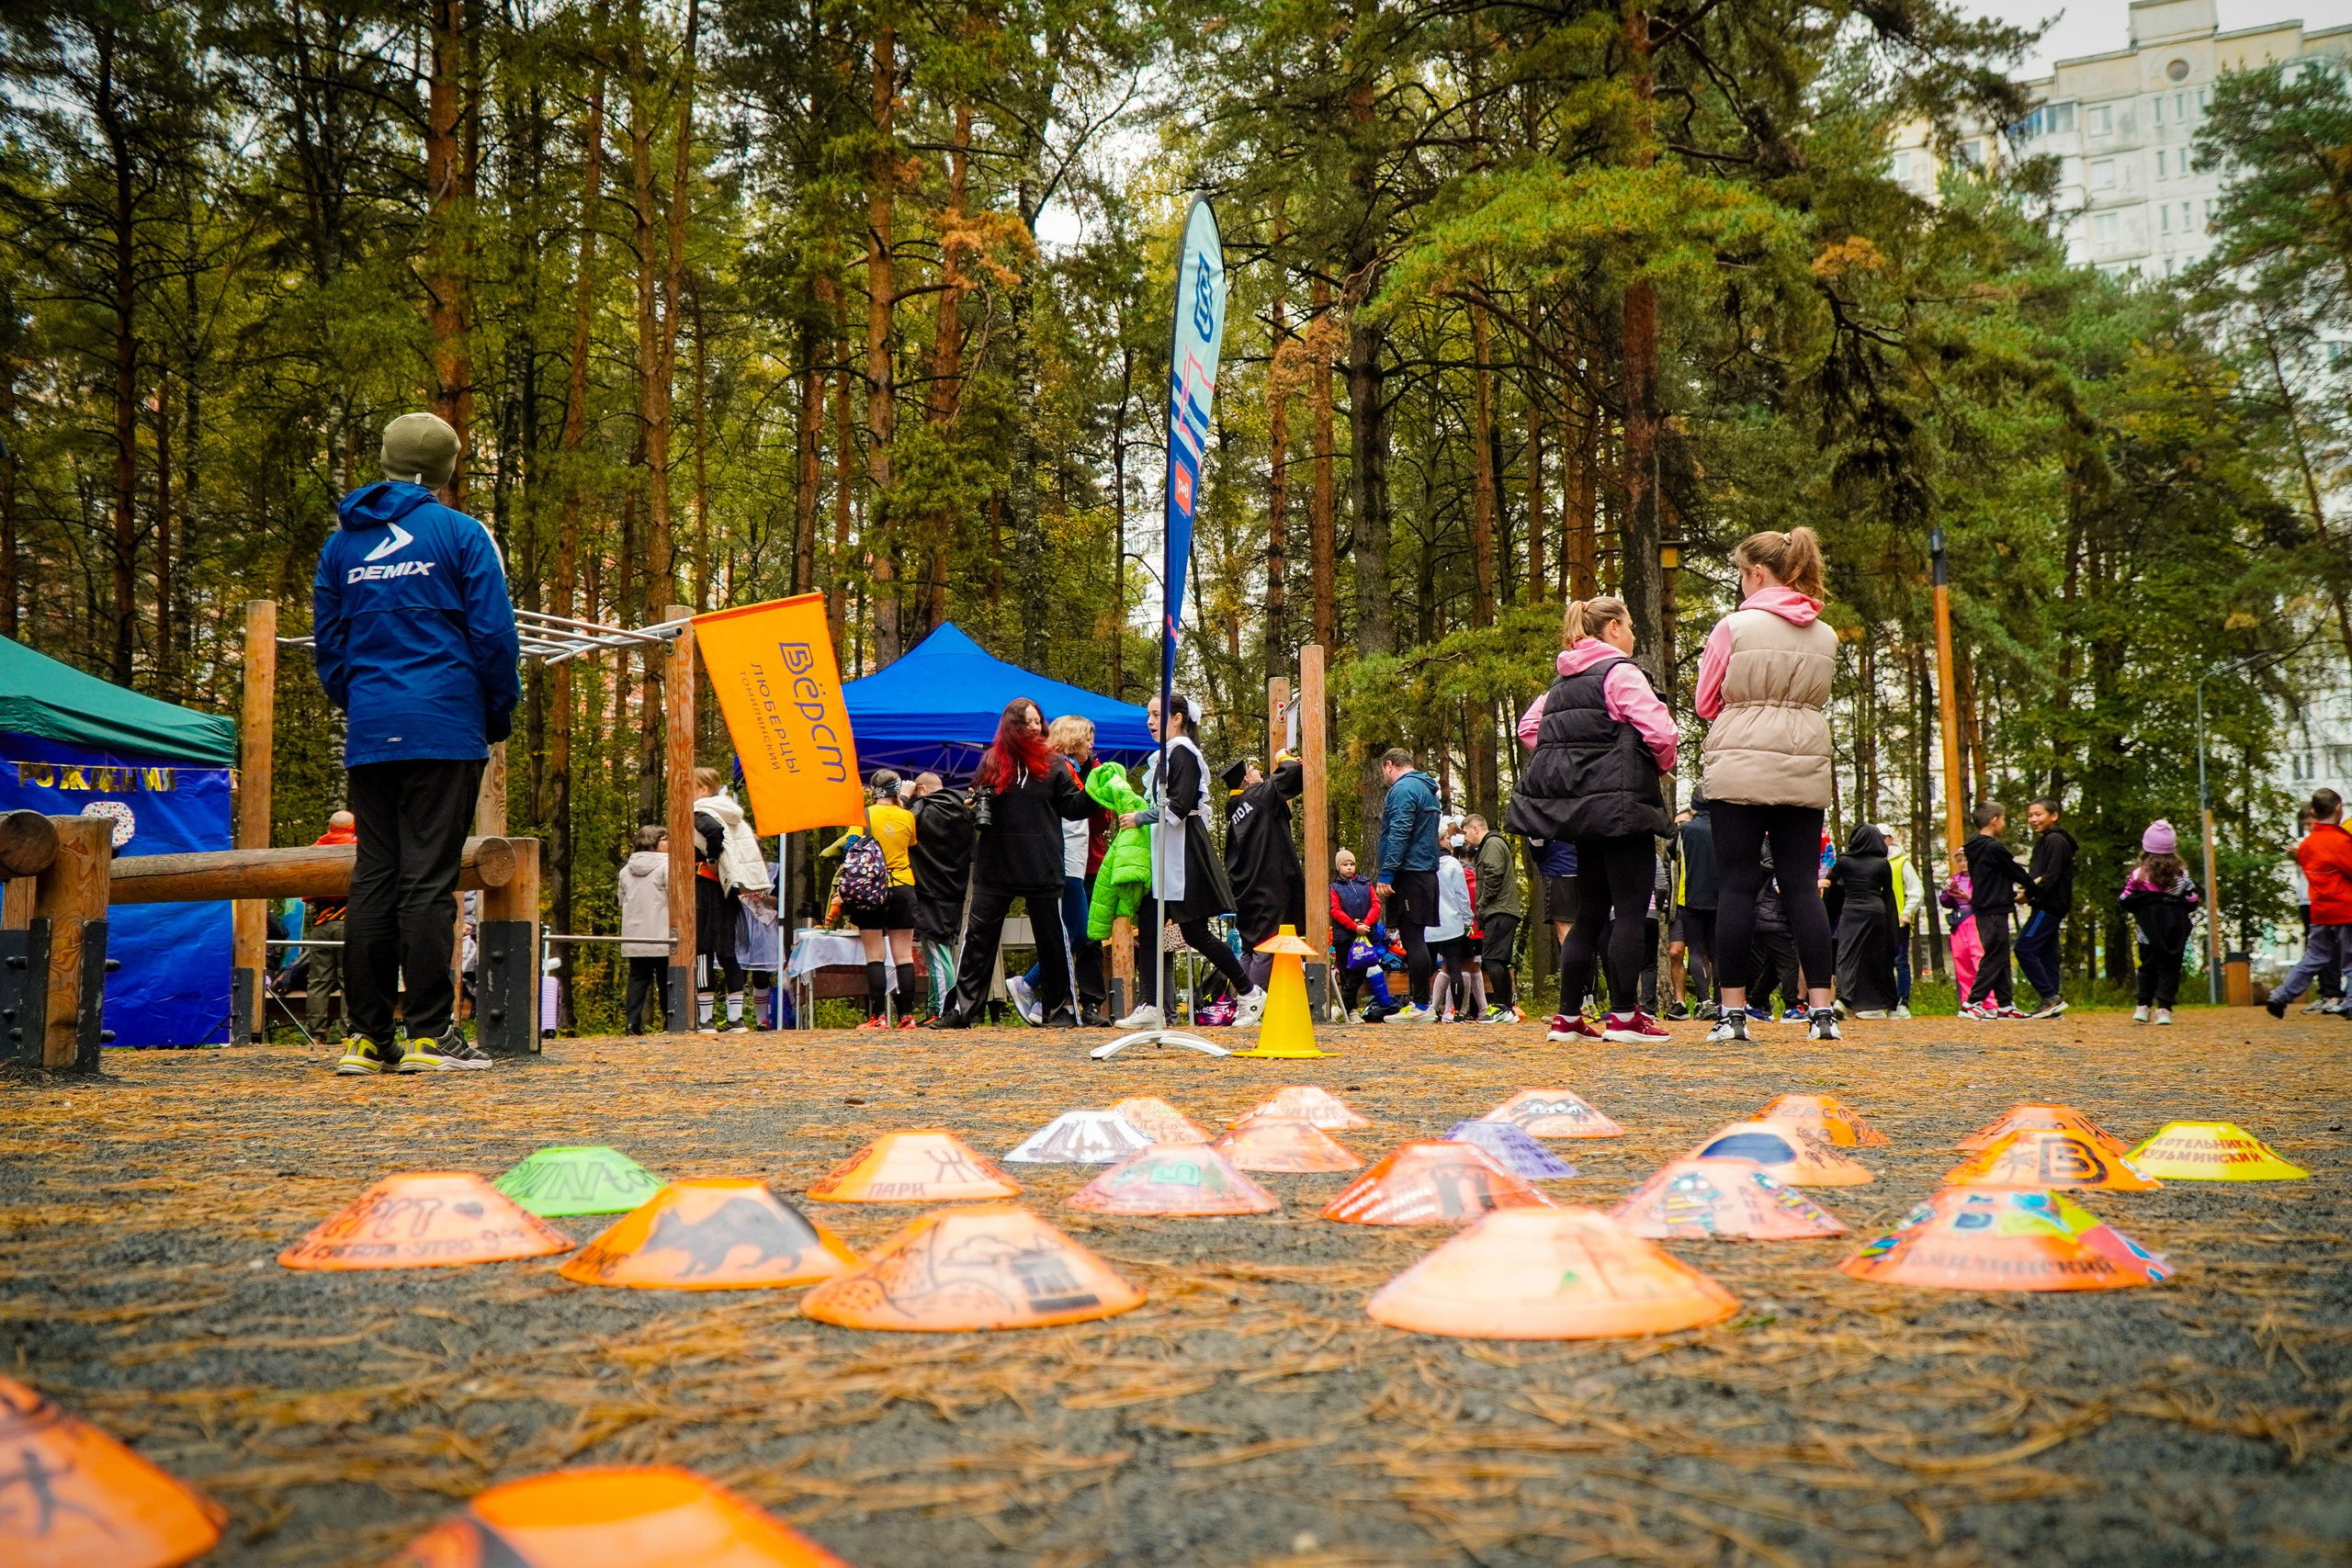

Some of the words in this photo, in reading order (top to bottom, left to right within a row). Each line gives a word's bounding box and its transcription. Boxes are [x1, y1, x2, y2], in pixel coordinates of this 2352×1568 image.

[347, 560, 435, 584] DEMIX
[739, 670, 781, 770] ТОМИЛИНСКИЙ
[750, 662, 801, 773] ЛЮБЕРЦЫ
[18, 761, 176, 792] РОЖДЕНИЯ
[2134, 1147, 2265, 1164] КУЗЬМИНСКИЙ
[2153, 1137, 2256, 1150] КОТЕЛЬНИКИ
